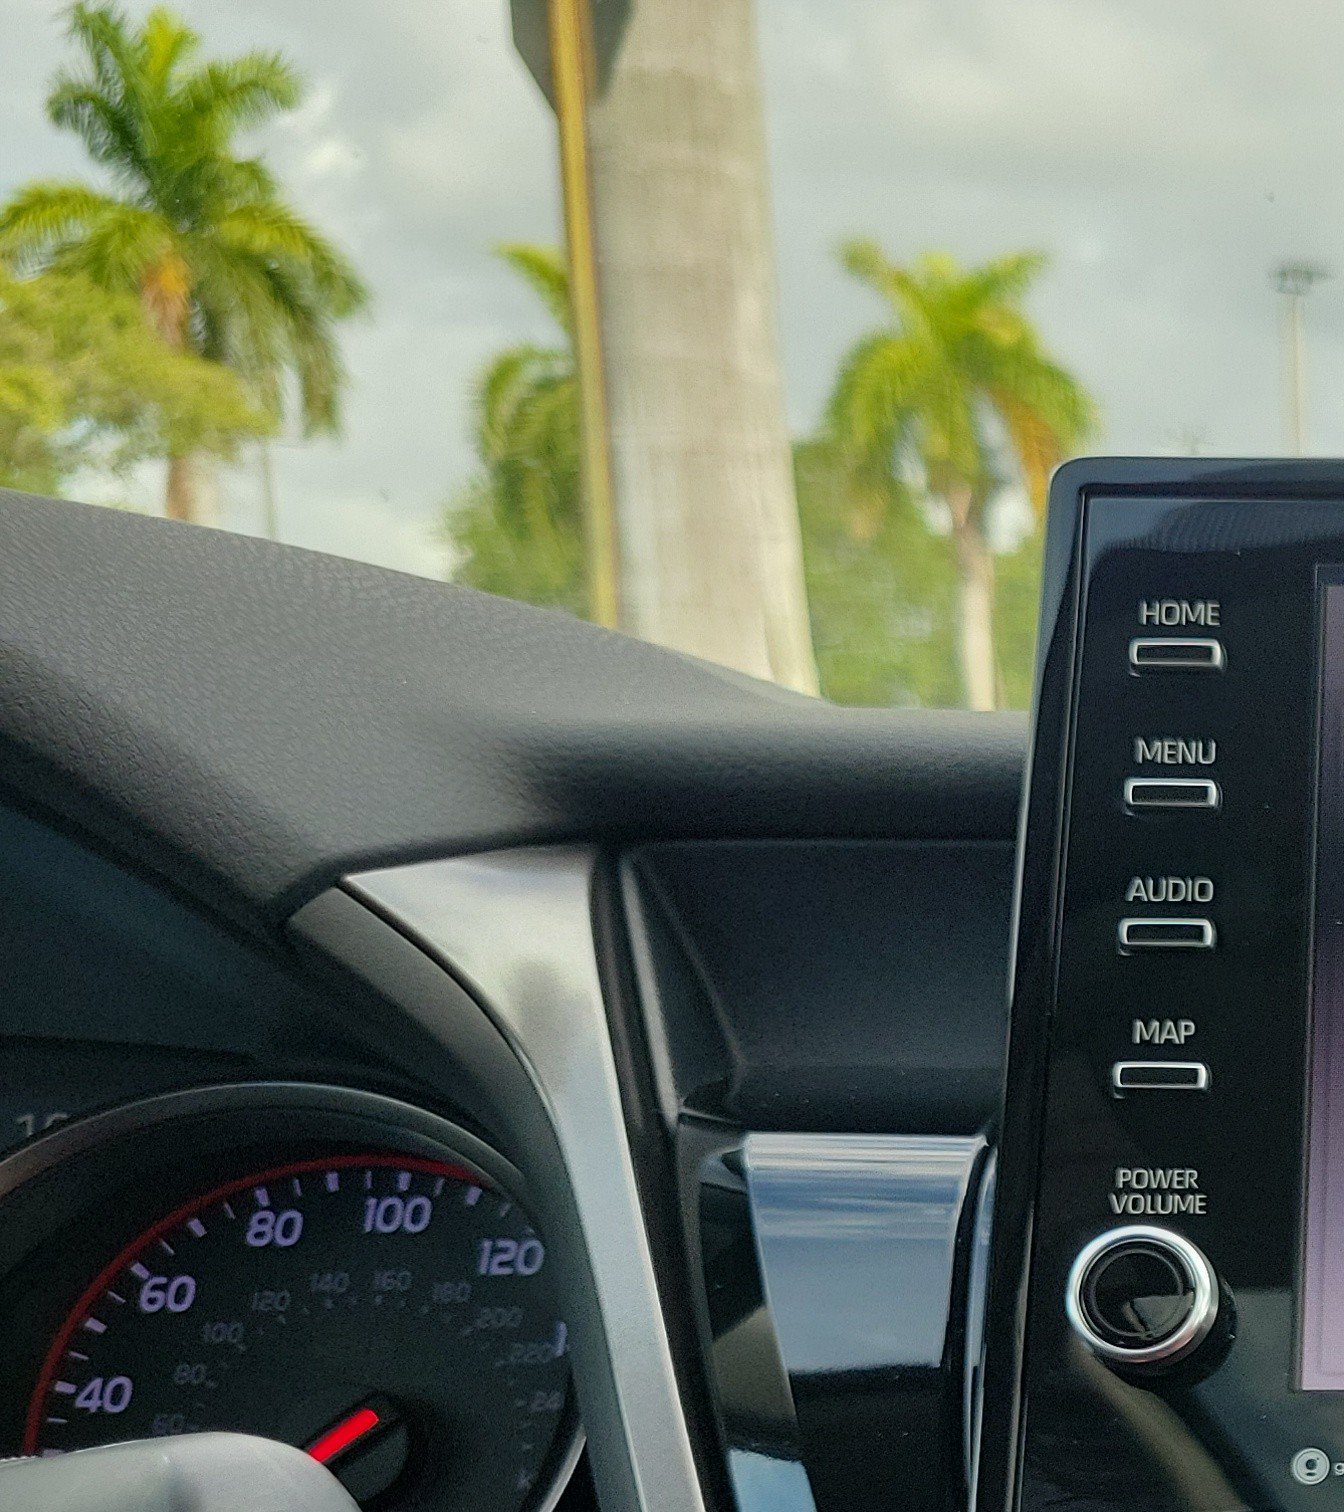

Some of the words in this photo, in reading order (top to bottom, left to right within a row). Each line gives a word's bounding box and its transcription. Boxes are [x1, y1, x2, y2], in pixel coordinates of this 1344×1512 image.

[1139, 601, 1221, 627] HOME
[1134, 739, 1218, 765] MENU
[1126, 876, 1215, 903] AUDIO
[1131, 1018, 1196, 1046] MAP
[1116, 1167, 1200, 1191] POWER
[363, 1195, 433, 1234] 100
[1109, 1192, 1208, 1216] VOLUME
[244, 1208, 303, 1247] 80
[477, 1237, 545, 1277] 120
[138, 1274, 196, 1313] 60
[309, 1270, 351, 1294] 140
[371, 1269, 412, 1292] 160
[250, 1289, 292, 1313] 120
[201, 1321, 244, 1346] 100
[173, 1361, 207, 1387] 80
[73, 1374, 134, 1414] 40
